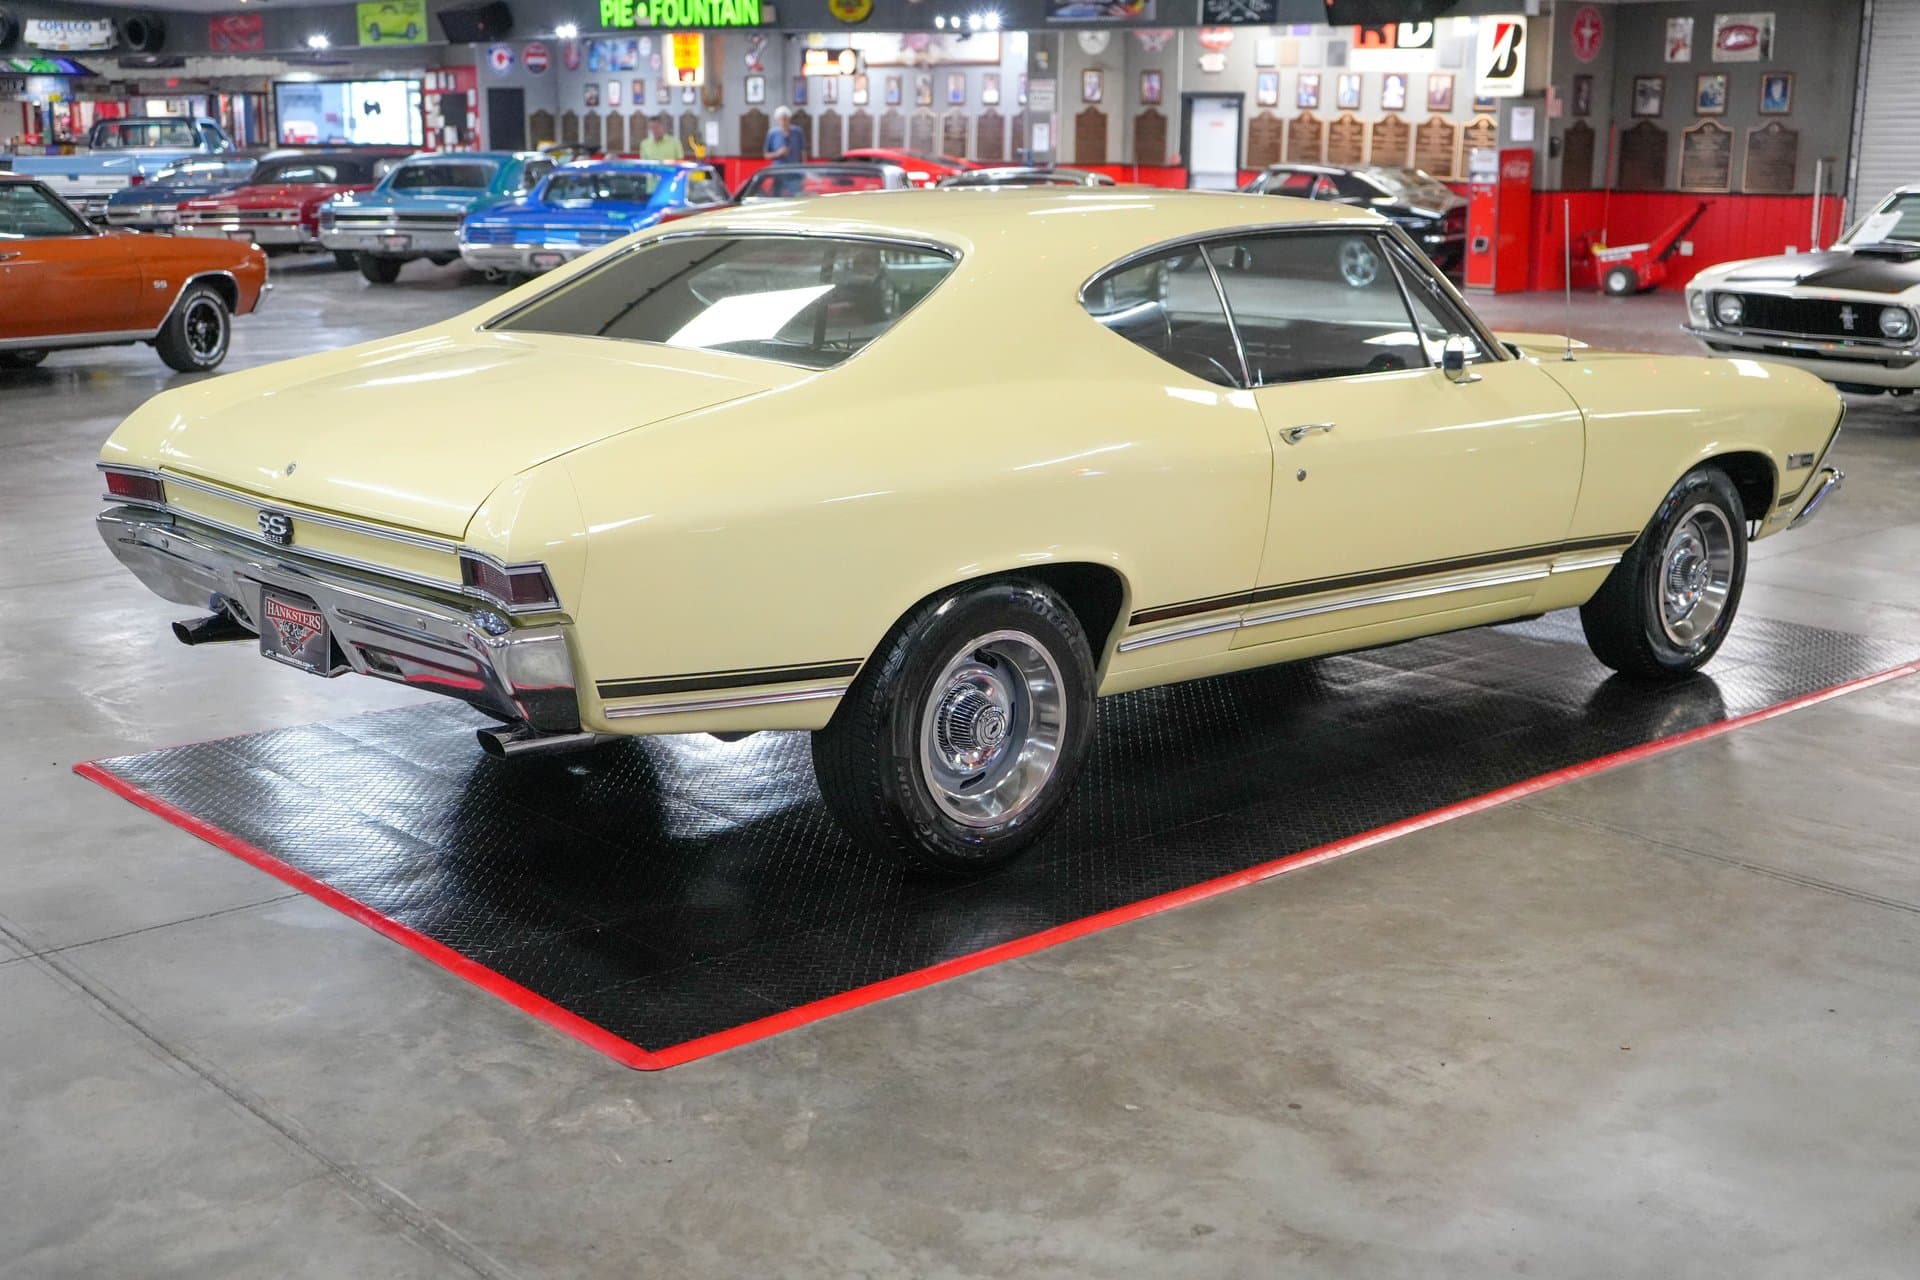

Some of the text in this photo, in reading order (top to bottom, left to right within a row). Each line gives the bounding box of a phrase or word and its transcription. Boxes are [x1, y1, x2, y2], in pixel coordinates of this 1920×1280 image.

[600, 0, 760, 28] PIE FOUNTAIN
[257, 512, 287, 535] SS
[267, 600, 321, 630] HANKSTERS
